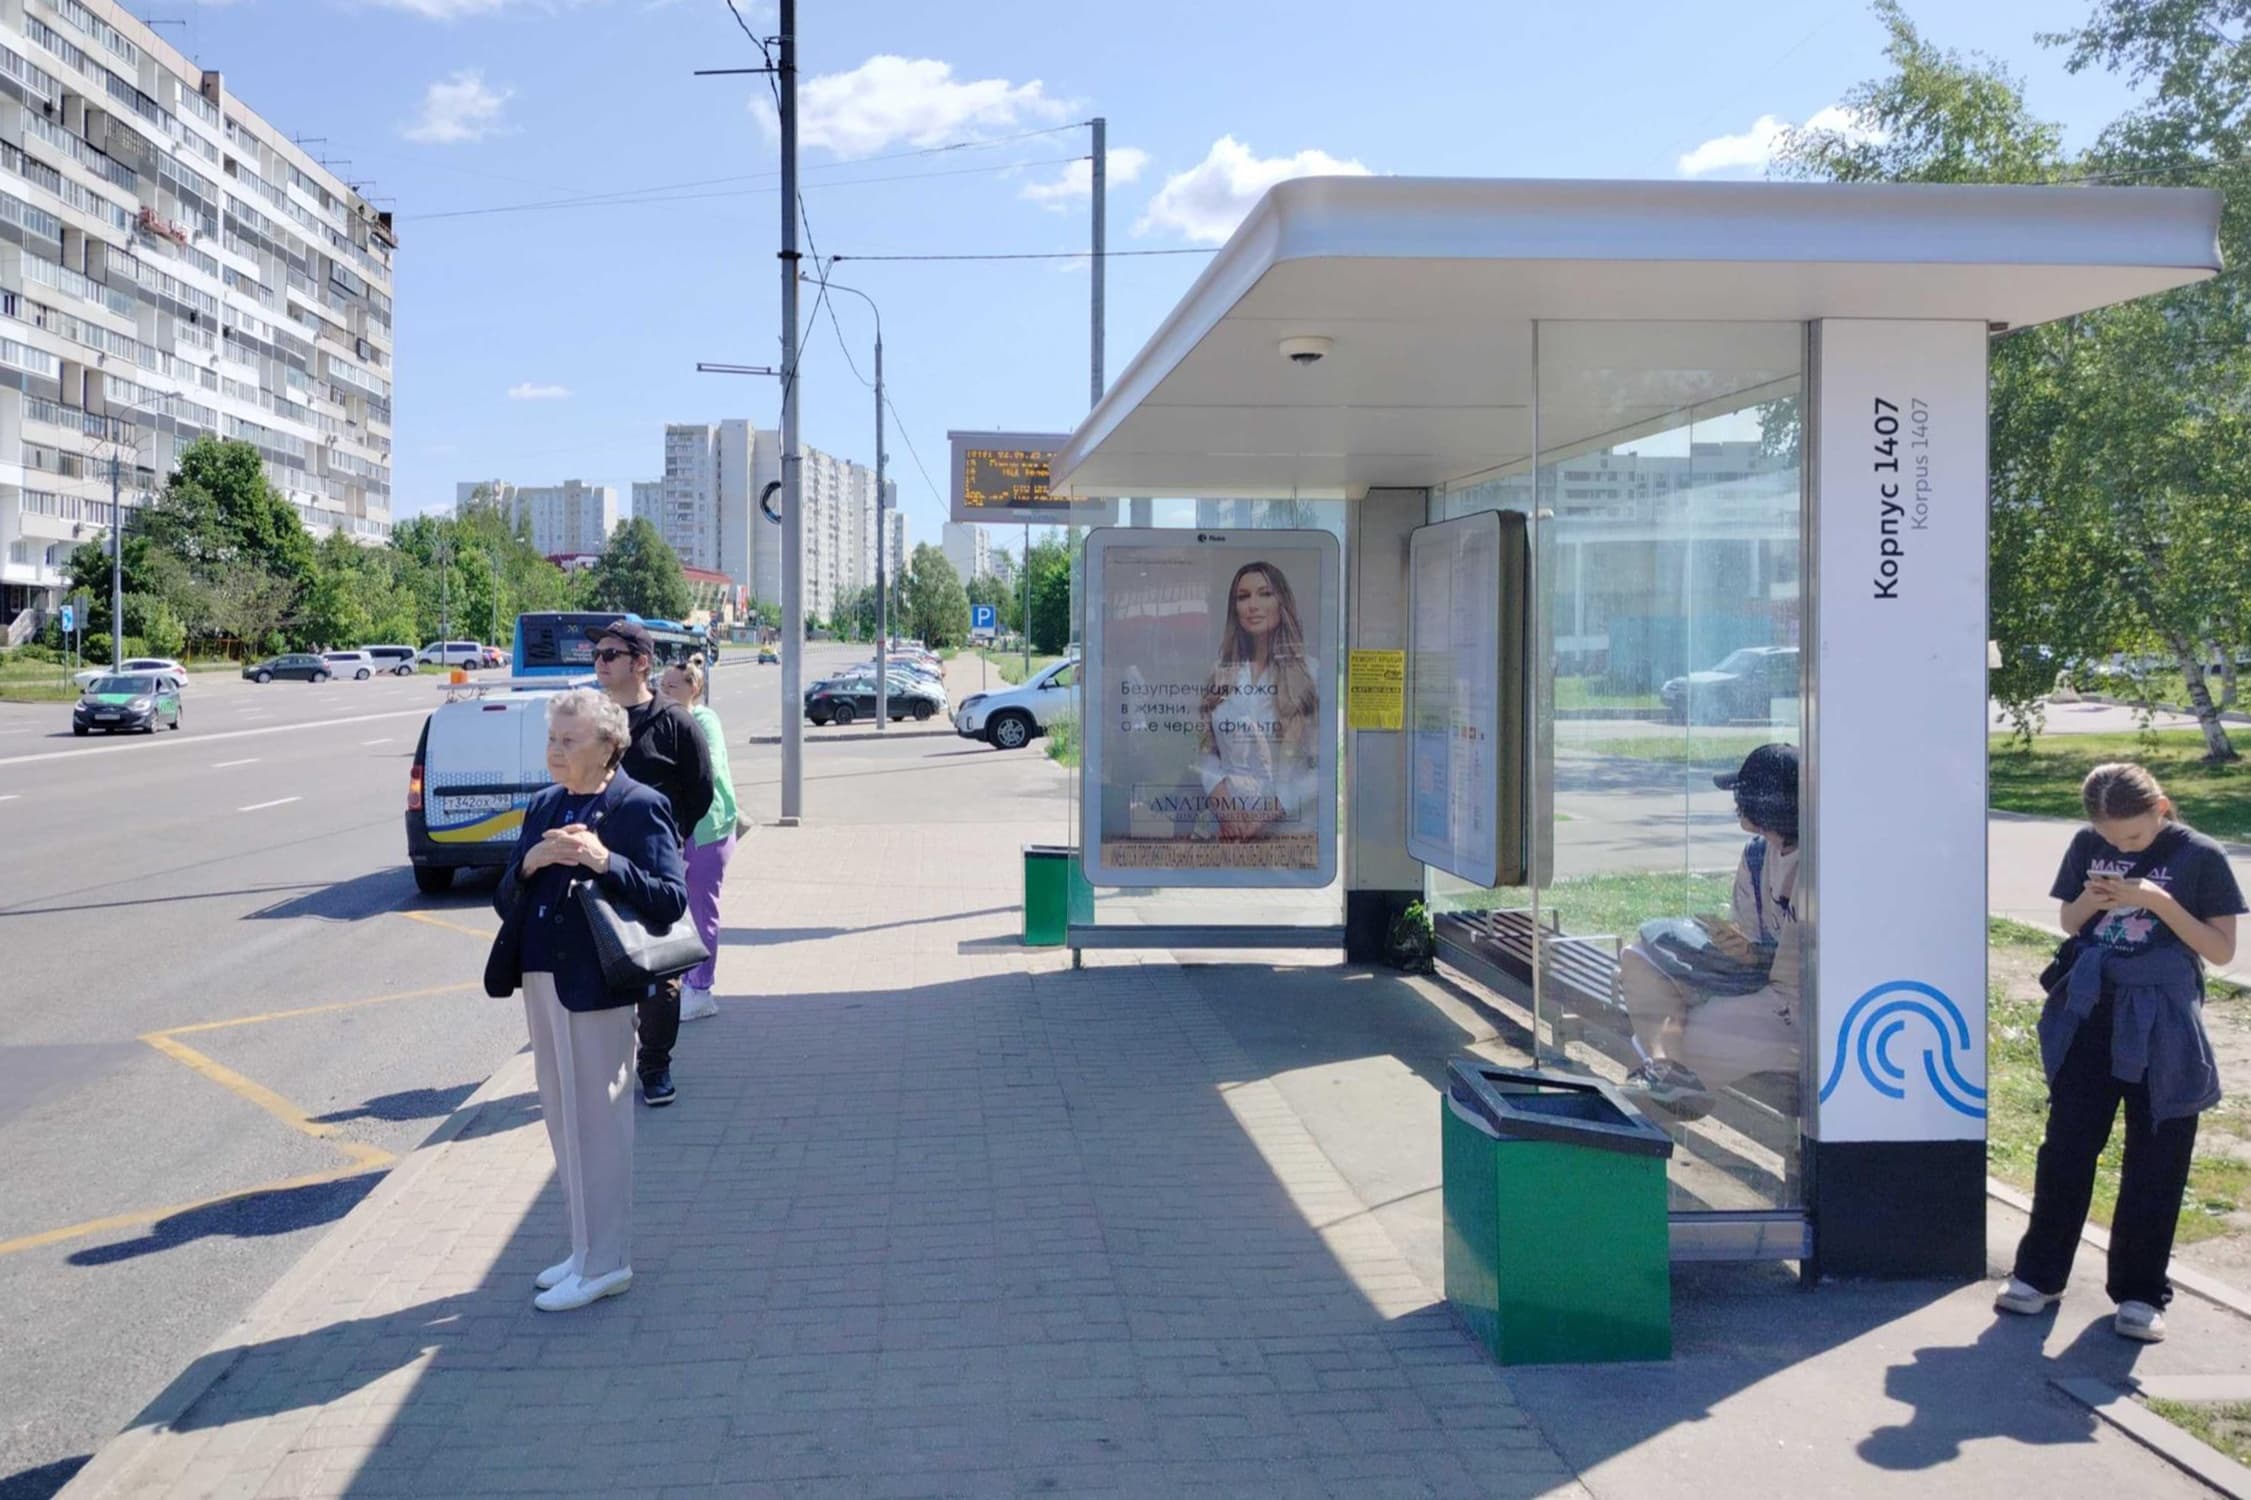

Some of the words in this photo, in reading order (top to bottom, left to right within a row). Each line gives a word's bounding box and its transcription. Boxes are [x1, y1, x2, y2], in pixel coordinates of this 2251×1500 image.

[1873, 397, 1899, 472] 1407
[1911, 398, 1929, 448] 1407
[1911, 455, 1933, 530] Korpus
[1873, 483, 1905, 599] Корпус
[978, 607, 992, 626] P
[1120, 681, 1229, 700] Безупречная
[1233, 684, 1278, 696] кожа
[1120, 704, 1128, 714] в
[1217, 716, 1282, 736] фильтр
